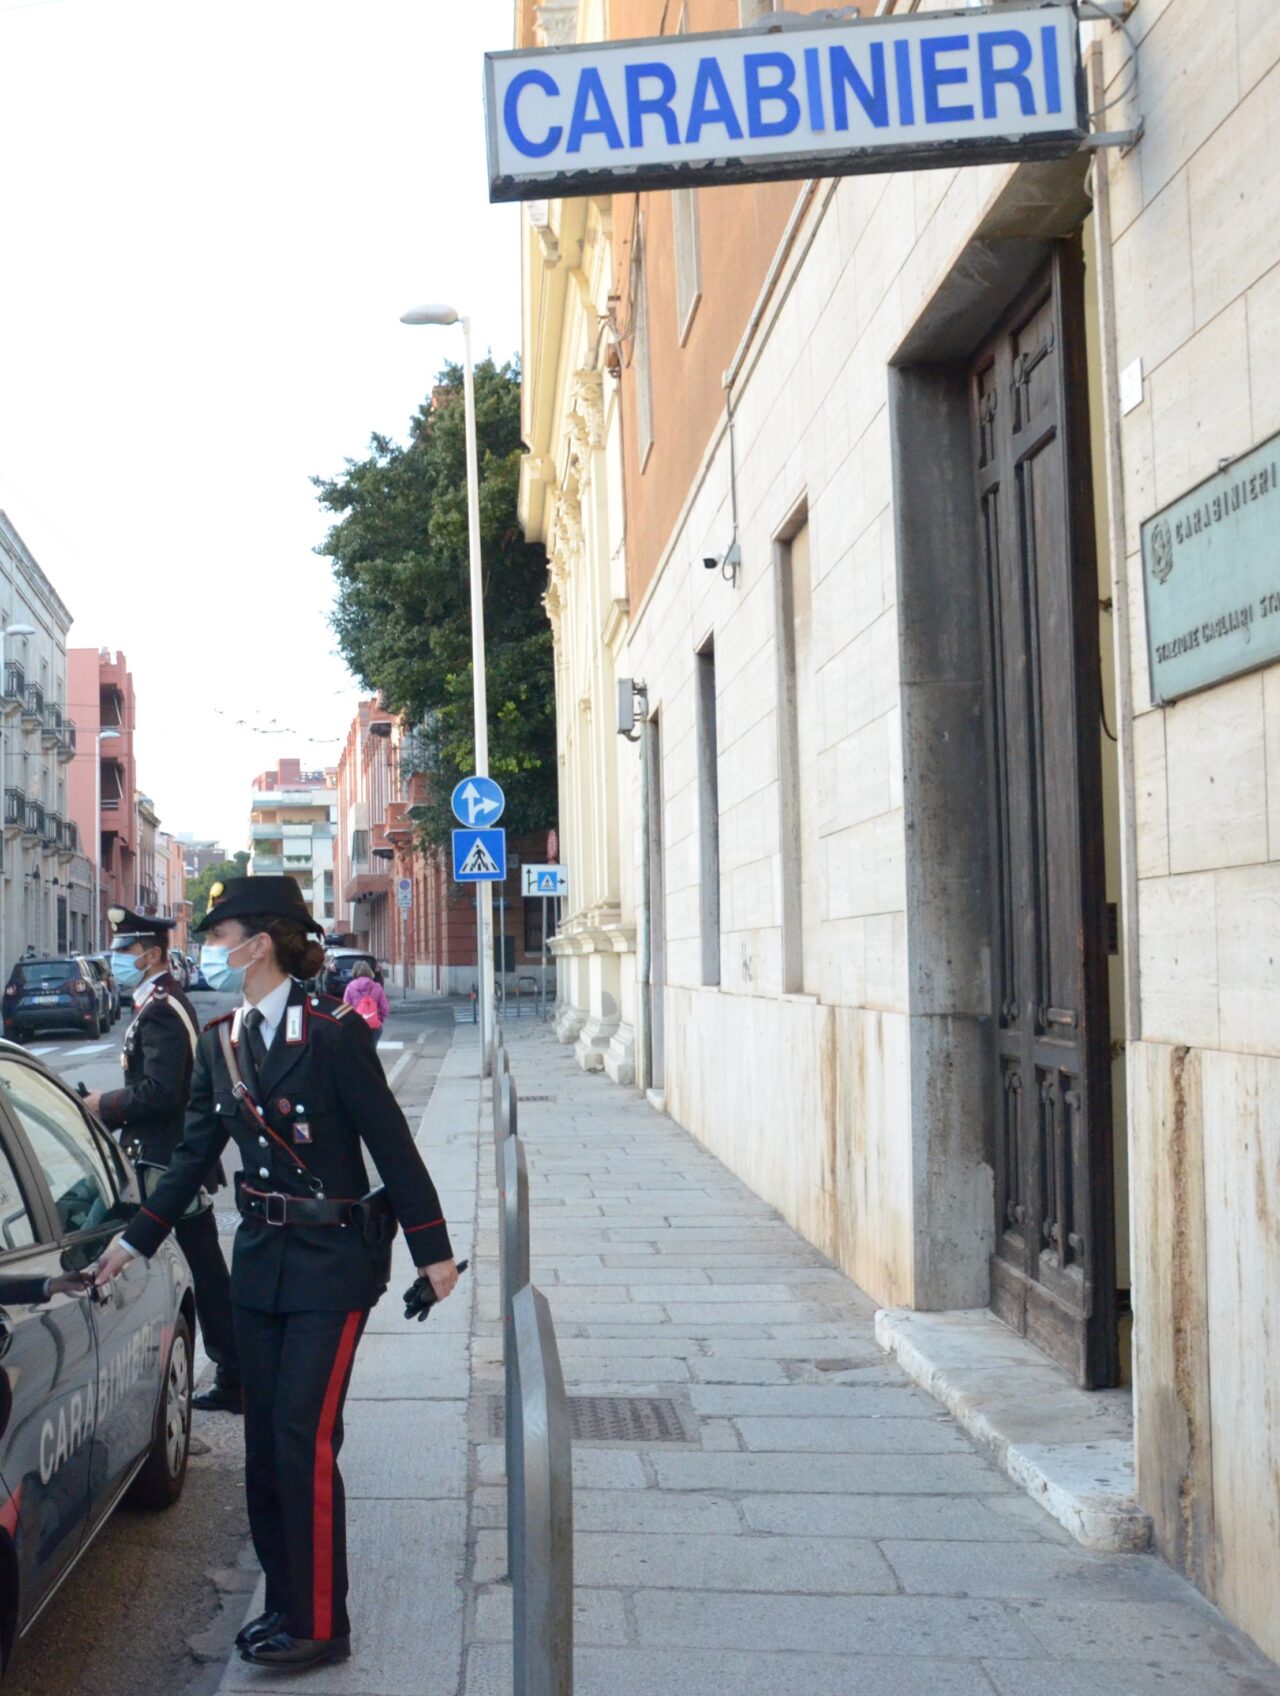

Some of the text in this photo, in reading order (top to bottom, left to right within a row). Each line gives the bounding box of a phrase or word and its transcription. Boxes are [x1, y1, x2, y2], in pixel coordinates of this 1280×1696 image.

[503, 25, 1063, 159] CARABINIERI
[1175, 461, 1277, 545] CARABINIERI
[1201, 604, 1253, 643] CAGLIARI
